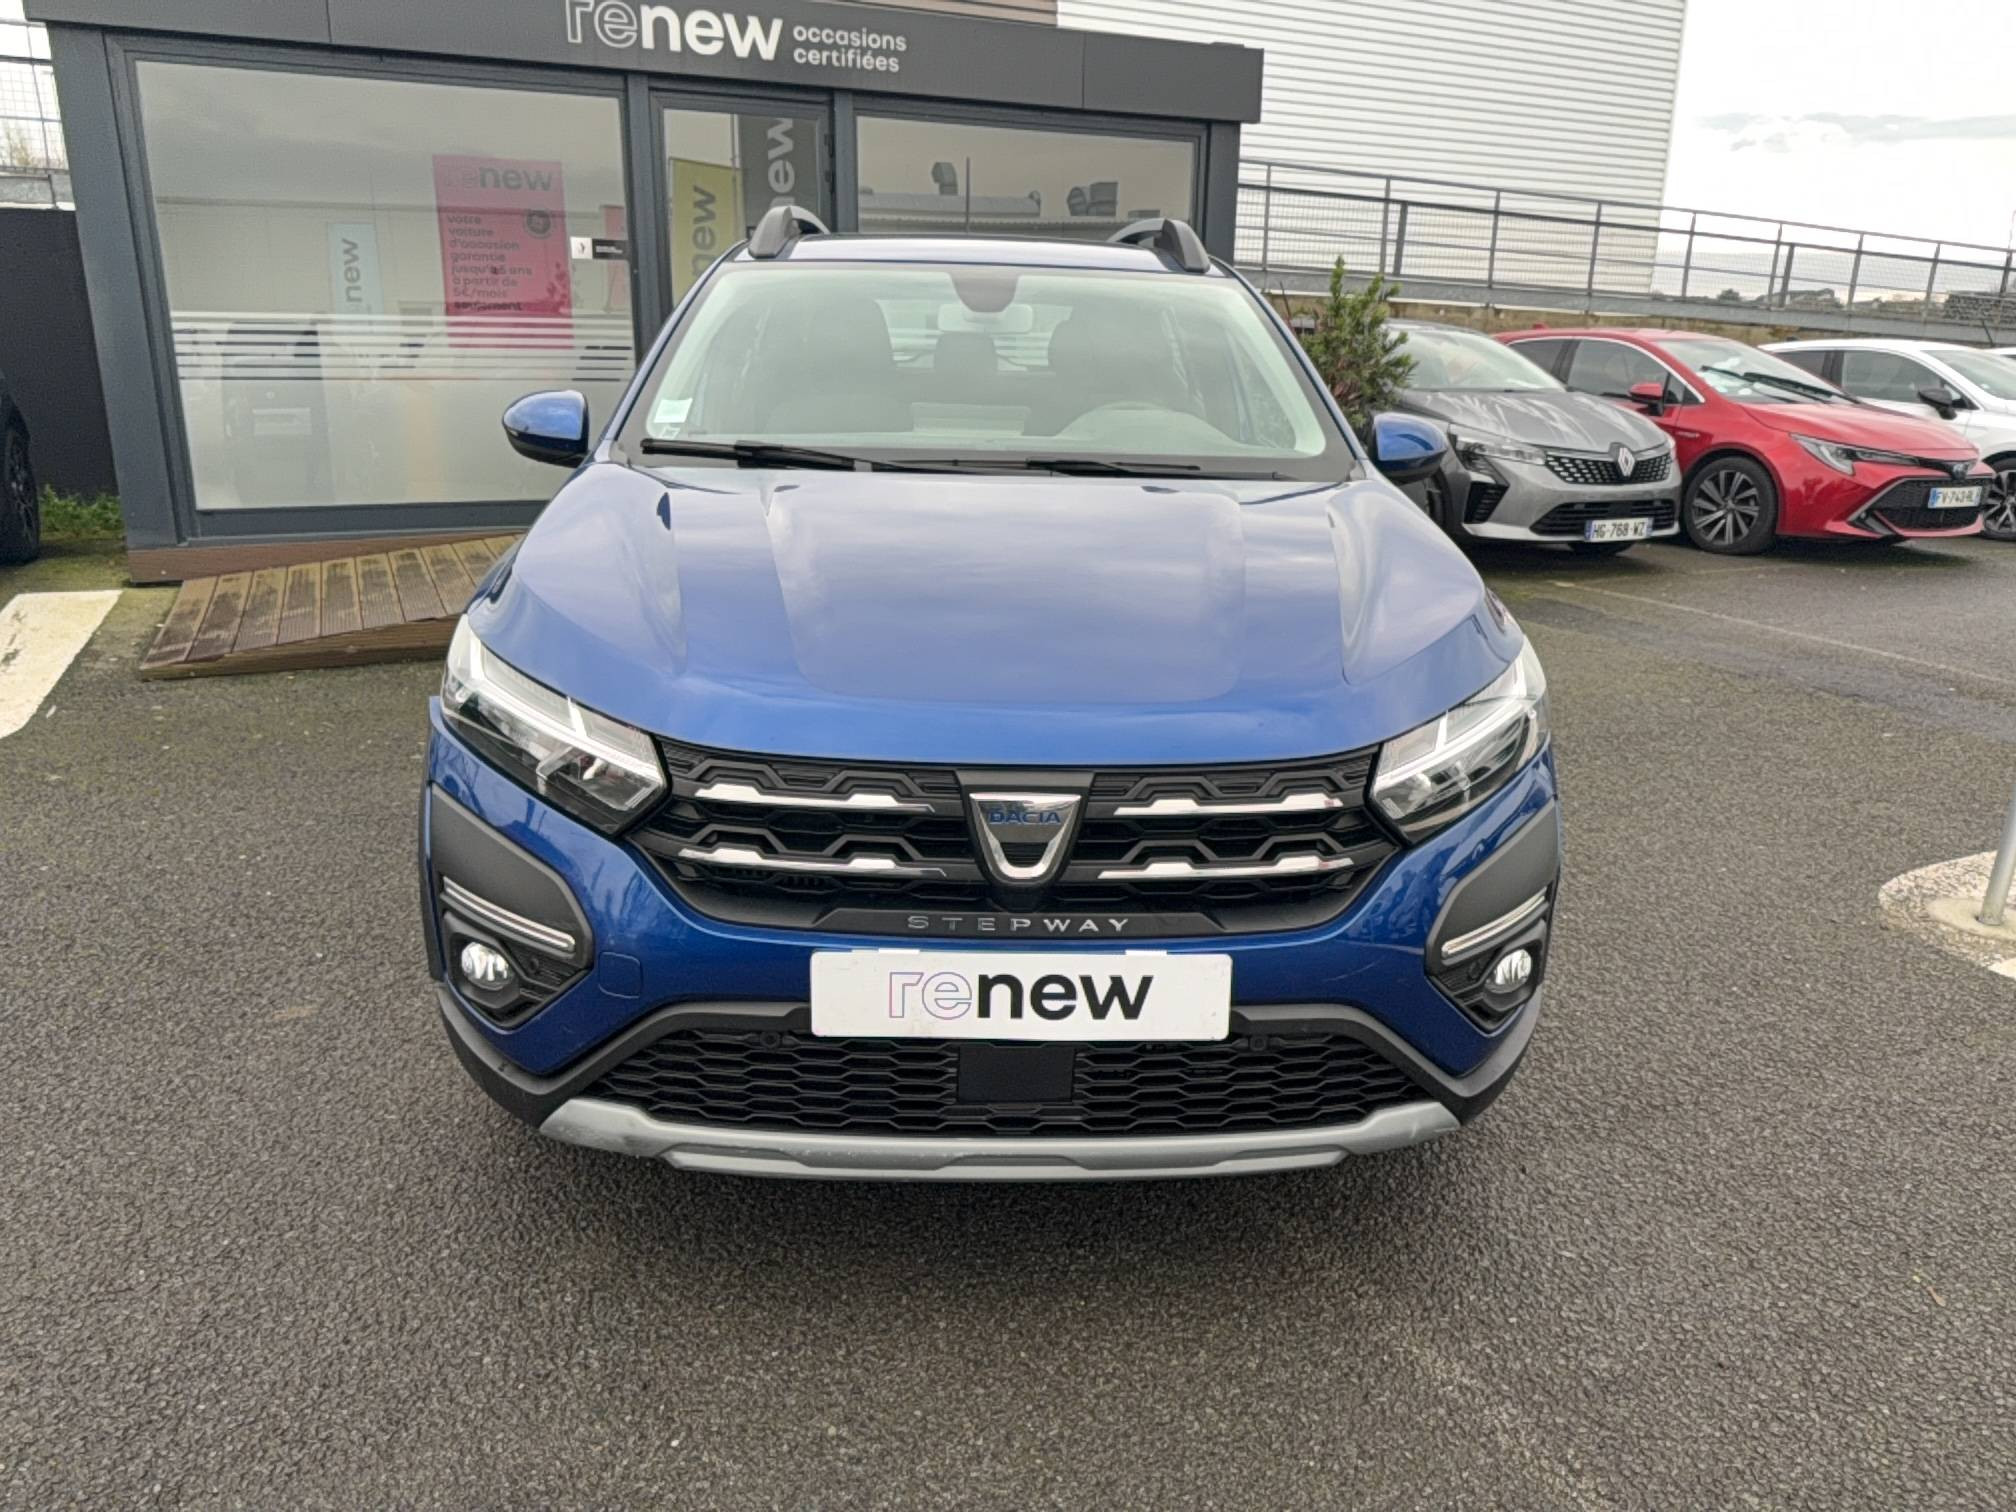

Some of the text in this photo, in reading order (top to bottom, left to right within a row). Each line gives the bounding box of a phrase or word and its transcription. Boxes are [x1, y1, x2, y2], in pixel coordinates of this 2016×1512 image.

[564, 0, 783, 60] renew
[792, 25, 907, 51] occasions
[793, 46, 900, 72] certifiées
[988, 810, 1062, 824] DACIA
[907, 915, 1130, 933] STEPWAY
[888, 971, 1154, 1021] renew
